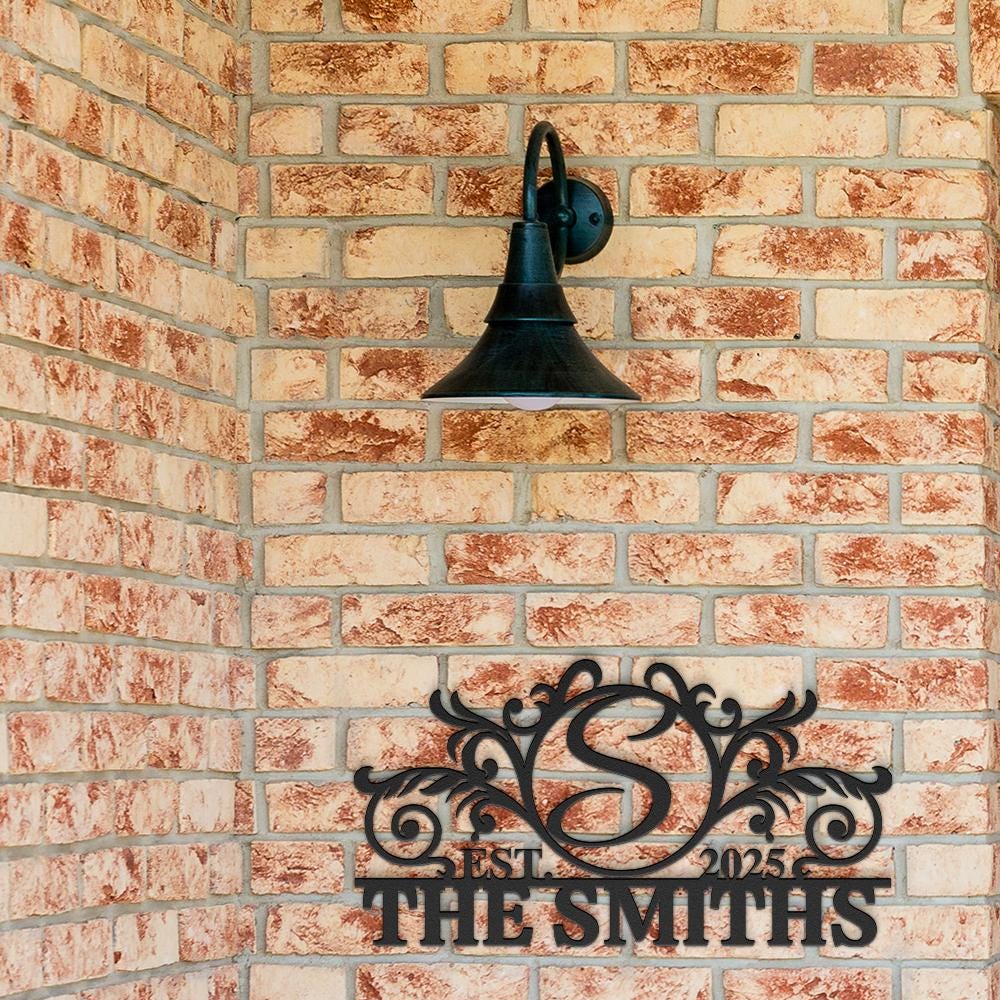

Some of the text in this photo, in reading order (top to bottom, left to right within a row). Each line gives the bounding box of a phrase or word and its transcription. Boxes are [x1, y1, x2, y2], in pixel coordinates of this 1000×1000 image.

[547, 693, 684, 848] S
[462, 847, 554, 880] EST.
[699, 847, 786, 880] 2025
[362, 882, 880, 948] THE SMITHS
